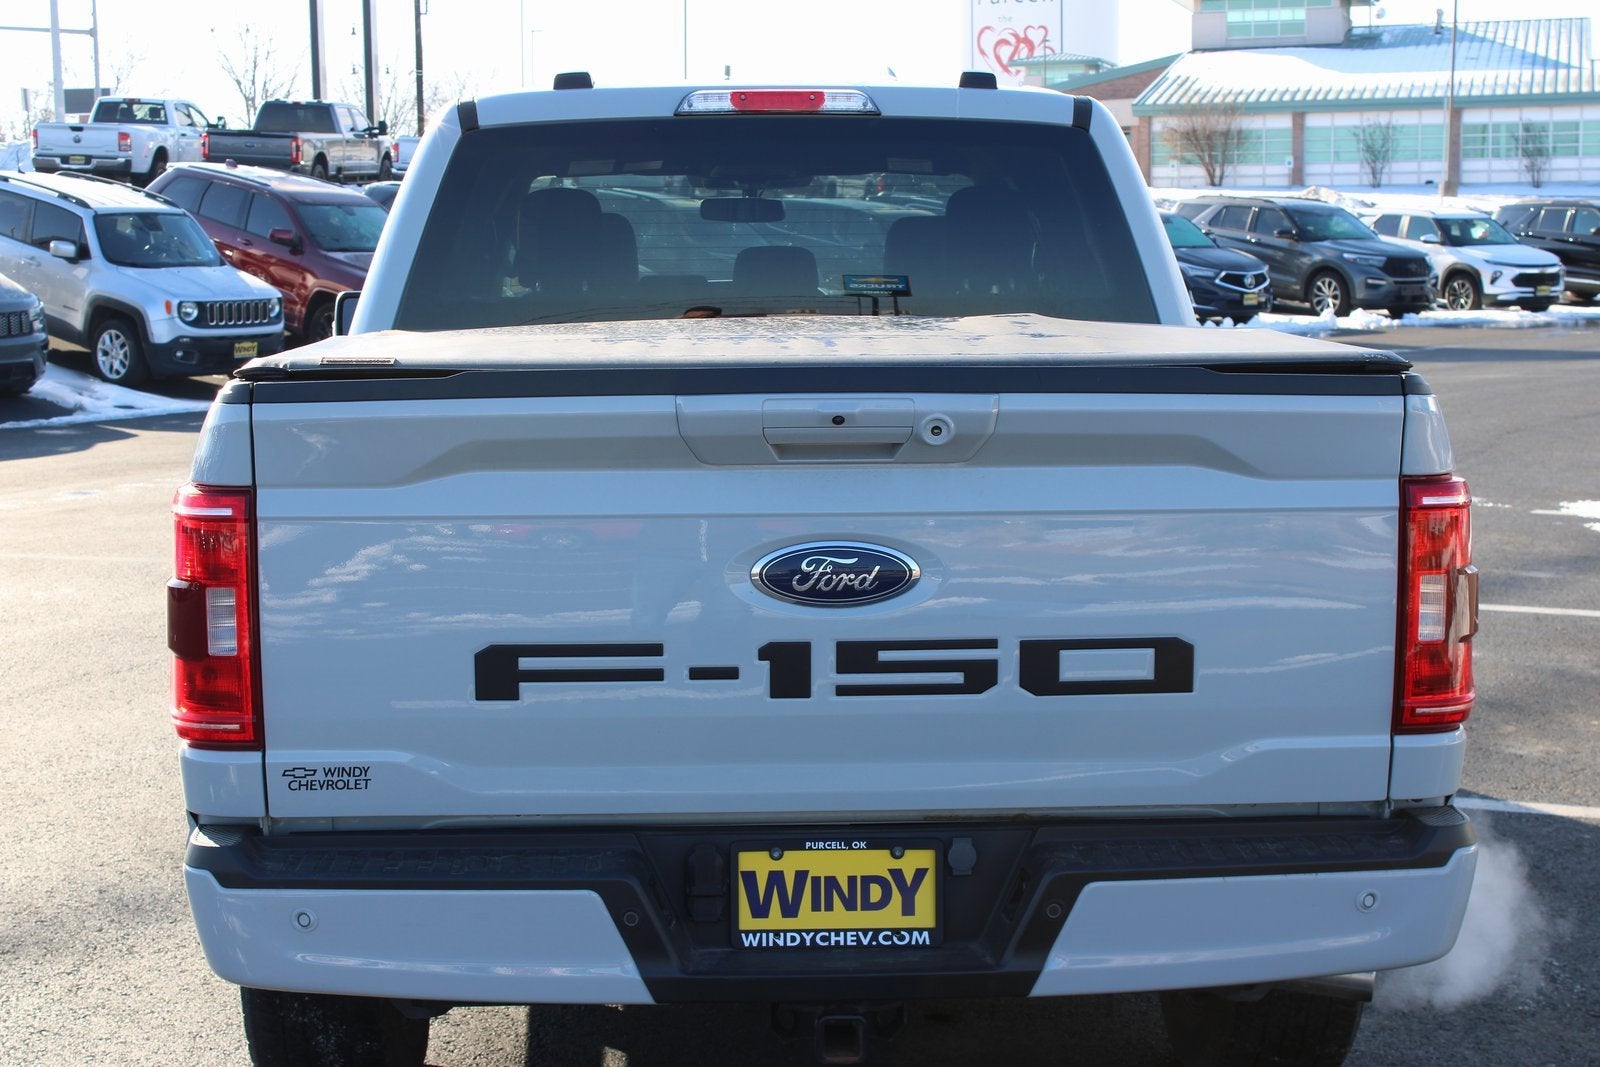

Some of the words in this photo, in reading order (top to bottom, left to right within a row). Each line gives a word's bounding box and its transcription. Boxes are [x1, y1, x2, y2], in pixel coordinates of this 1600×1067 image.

[791, 555, 881, 592] Ford
[474, 636, 1194, 701] F-150
[323, 766, 370, 778] WINDY
[288, 778, 372, 791] CHEVROLET
[805, 841, 849, 850] PURCELL,
[851, 841, 867, 849] OK
[740, 868, 930, 919] WINDY
[741, 930, 931, 947] WINDYCHEV.COM
